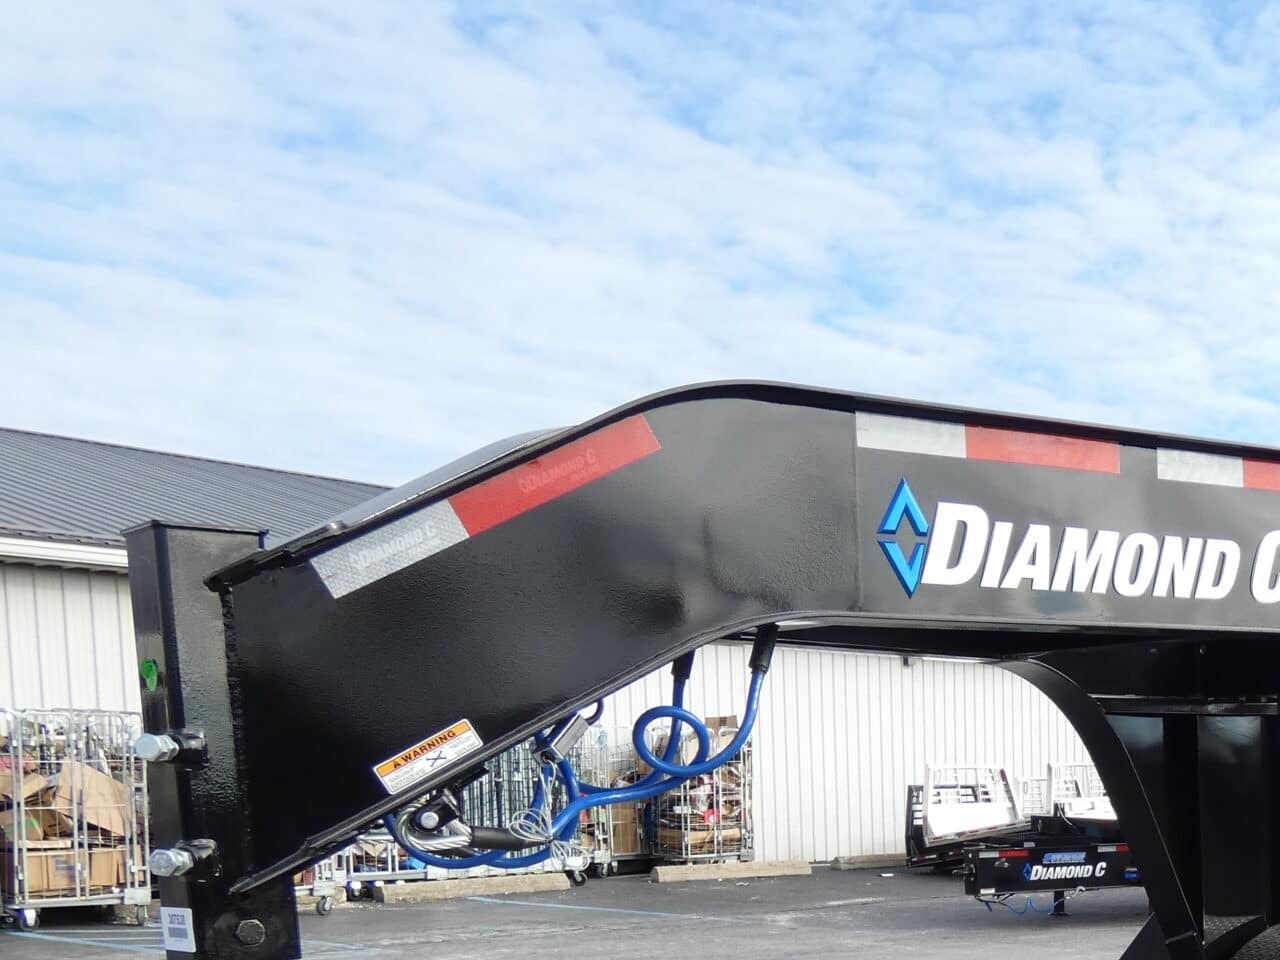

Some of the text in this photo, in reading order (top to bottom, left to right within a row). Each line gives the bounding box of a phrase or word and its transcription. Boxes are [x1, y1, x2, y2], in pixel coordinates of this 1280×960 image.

[921, 501, 1241, 600] DIAMOND
[401, 730, 456, 763] WARNING
[1030, 865, 1094, 881] DIAMOND
[1094, 861, 1107, 878] C
